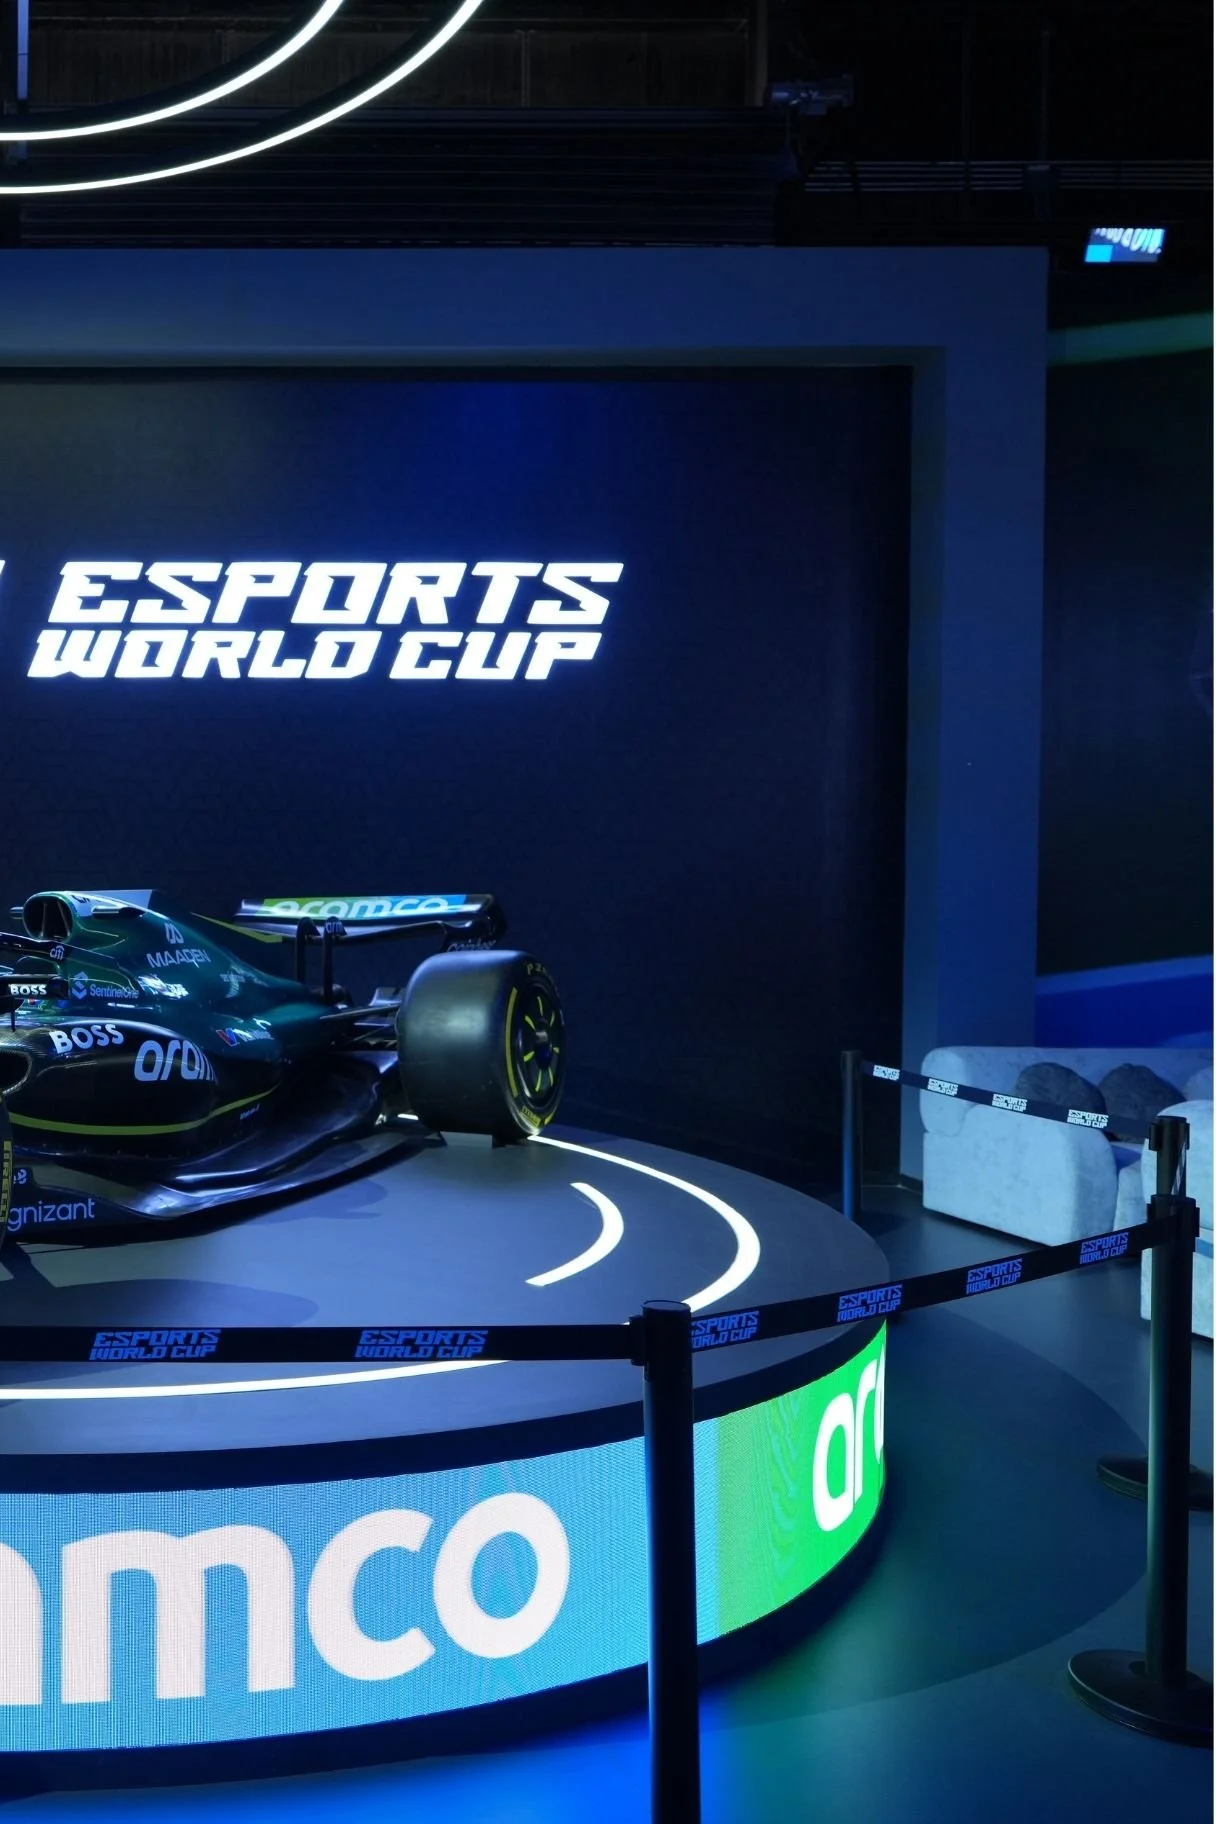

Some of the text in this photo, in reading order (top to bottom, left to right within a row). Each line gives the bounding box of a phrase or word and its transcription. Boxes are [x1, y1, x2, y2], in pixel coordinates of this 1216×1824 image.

[49, 561, 624, 625] ESPORTS
[27, 630, 602, 680] WORLD CUP
[274, 898, 449, 918] aramco
[146, 949, 211, 969] MAADEN
[10, 983, 47, 996] BOSS
[89, 983, 139, 999] SentinelOne
[49, 1023, 125, 1055] BOSS
[992, 1093, 1028, 1107] ESPORTS
[1068, 1109, 1109, 1123] ESPORTS
[1092, 1120, 1108, 1129] CUP
[6, 1198, 95, 1232] gnizant
[1081, 1231, 1130, 1254] ESPORTS
[1079, 1244, 1128, 1265] WORLD CUP
[967, 1258, 1023, 1282] ESPORTS
[966, 1271, 1021, 1295] WORLD CUP
[838, 1284, 903, 1310] ESPORTS
[836, 1299, 901, 1323] WORLD CUP
[94, 1329, 221, 1347] ESPORTS
[359, 1330, 488, 1345] ESPORTS
[691, 1327, 757, 1348] ORLD CUP
[89, 1345, 216, 1360] WORLD CUP
[355, 1345, 484, 1358] WORLD CUP
